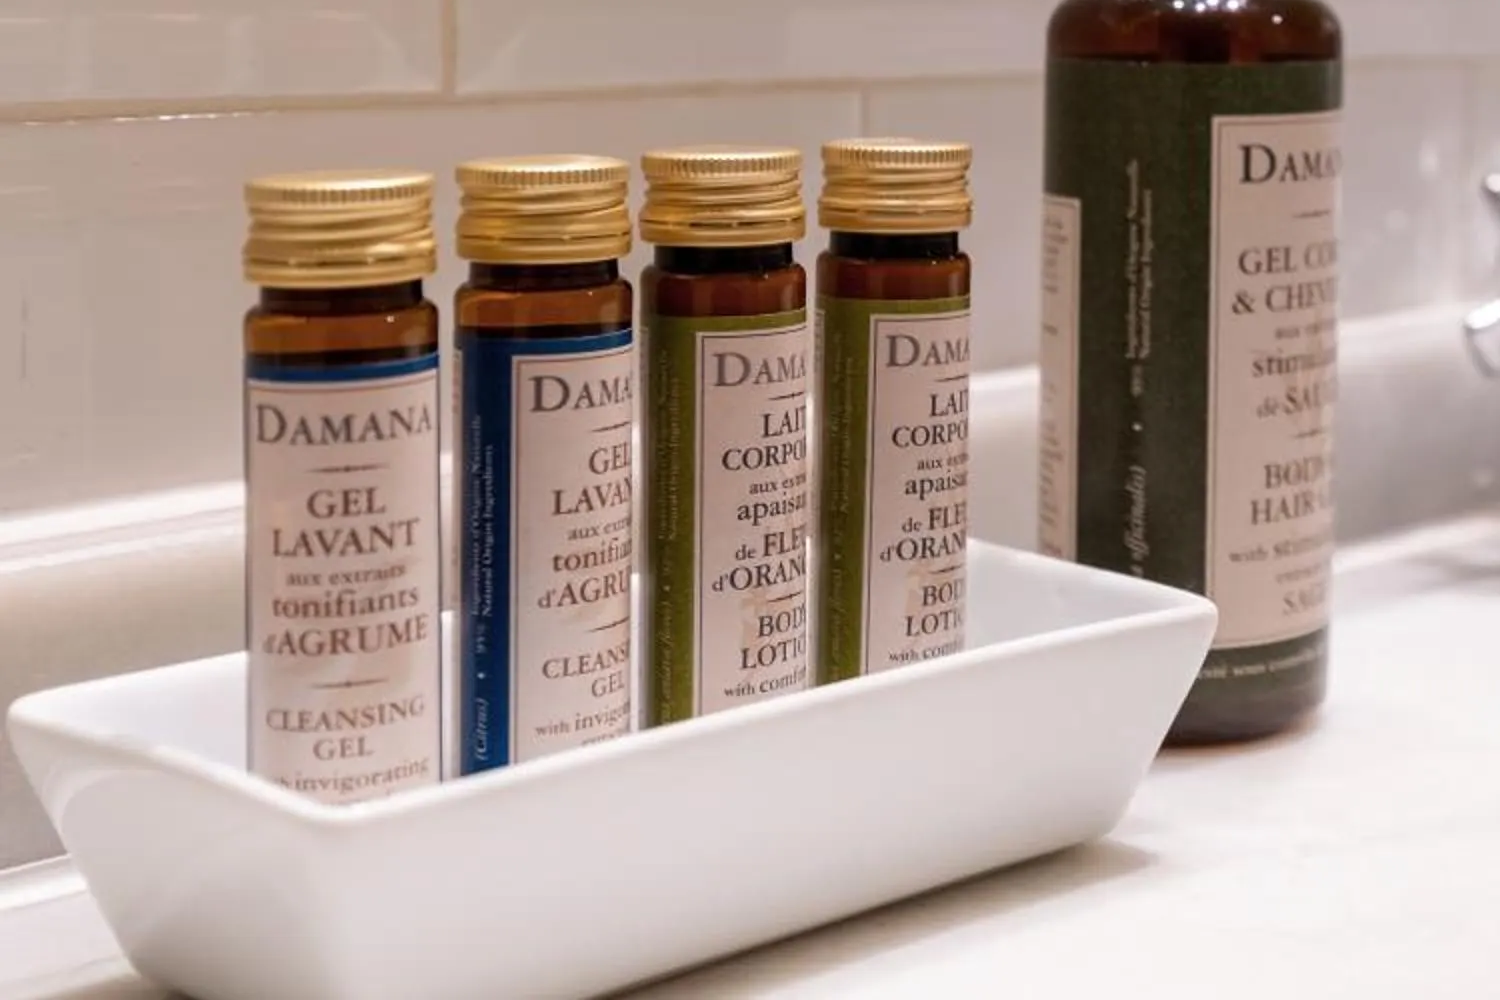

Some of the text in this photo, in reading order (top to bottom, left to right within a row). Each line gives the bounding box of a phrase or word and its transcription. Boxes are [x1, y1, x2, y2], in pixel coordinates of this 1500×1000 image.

[1238, 245, 1298, 275] GEL
[1231, 288, 1256, 315] &
[256, 402, 432, 445] DAMANA
[589, 441, 632, 475] GEL
[749, 481, 778, 495] aux
[306, 487, 387, 519] GEL
[273, 518, 420, 557] LAVANT
[902, 517, 922, 533] de
[735, 543, 757, 561] de
[272, 586, 418, 619] tonifiants
[591, 670, 625, 698] GEL
[724, 682, 756, 697] with
[266, 694, 425, 733] CLEANSING
[535, 720, 570, 736] with
[312, 736, 376, 761] GEL
